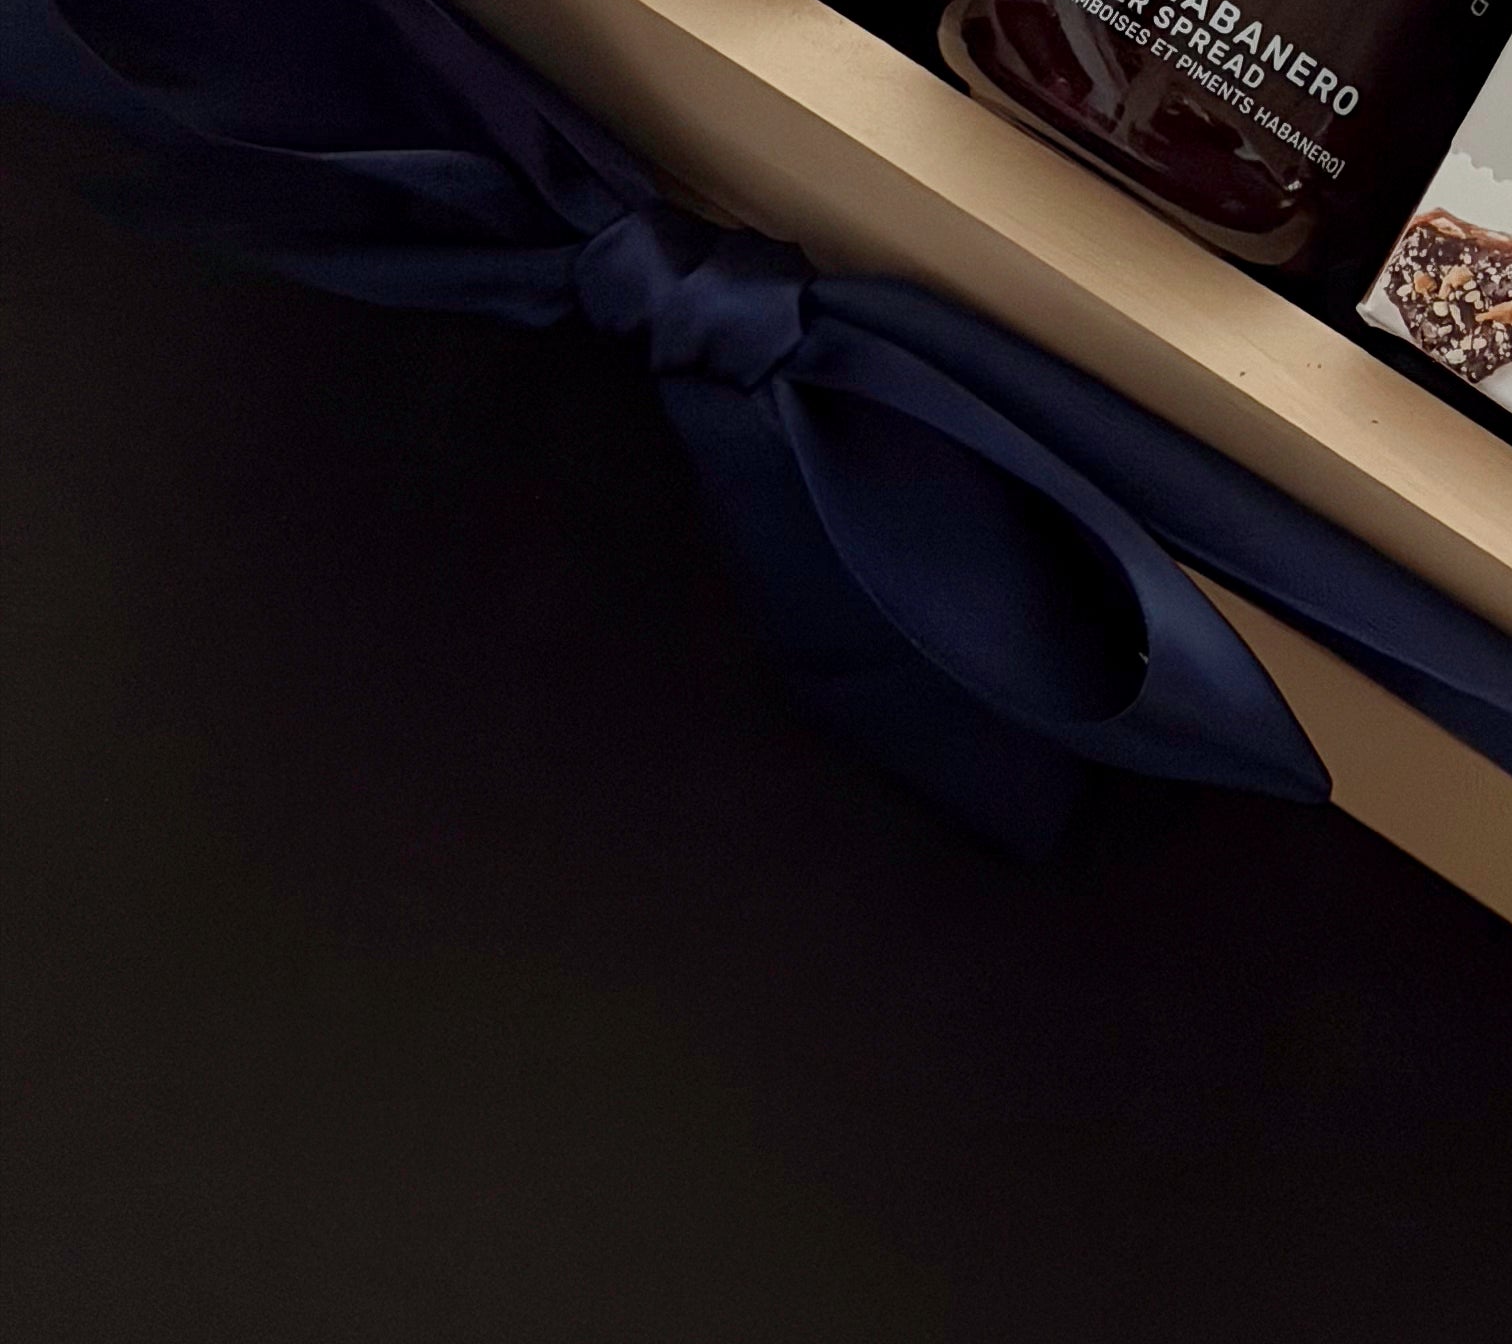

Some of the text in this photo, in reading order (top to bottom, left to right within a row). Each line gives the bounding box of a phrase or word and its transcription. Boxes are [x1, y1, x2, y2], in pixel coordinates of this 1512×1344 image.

[1153, 6, 1266, 89] SPREAD
[1150, 37, 1178, 62] ET
[1176, 54, 1255, 114] PIMENTS
[1253, 106, 1346, 179] HABANERO]
